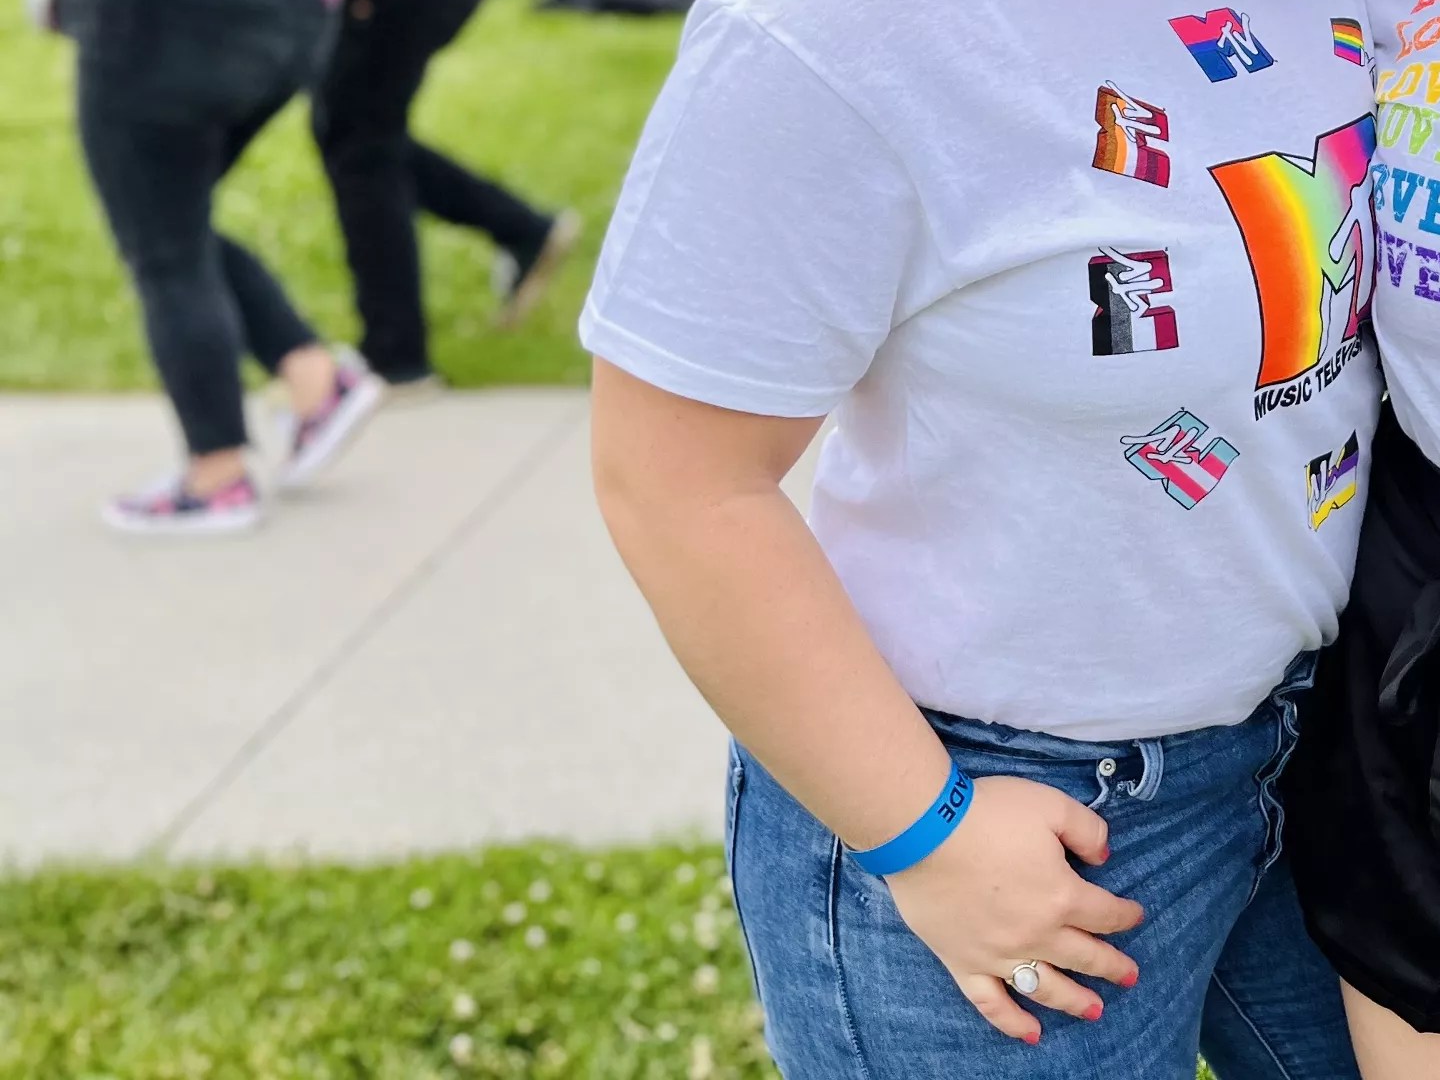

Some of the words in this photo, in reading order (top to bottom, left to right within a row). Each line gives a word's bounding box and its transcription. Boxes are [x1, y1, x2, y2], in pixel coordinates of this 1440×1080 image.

[1254, 376, 1312, 421] MUSIC
[1315, 340, 1362, 392] TELEVIS
[937, 770, 969, 823] ADE
